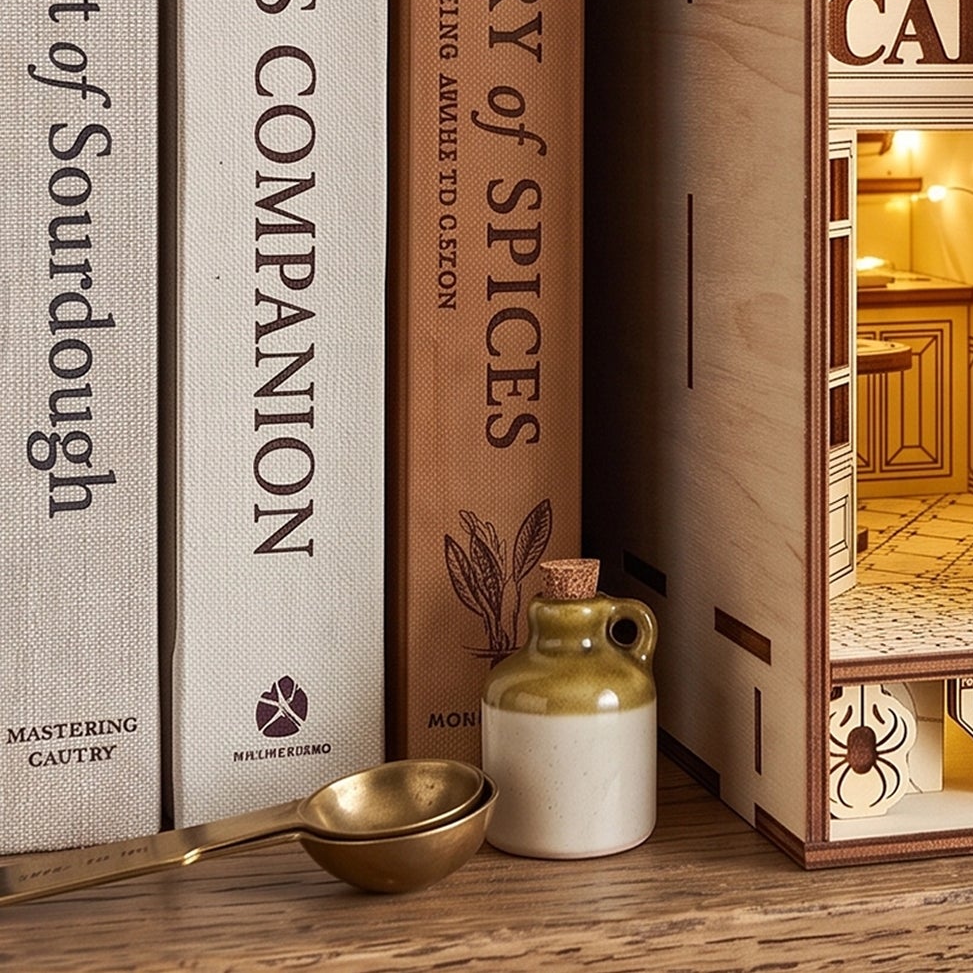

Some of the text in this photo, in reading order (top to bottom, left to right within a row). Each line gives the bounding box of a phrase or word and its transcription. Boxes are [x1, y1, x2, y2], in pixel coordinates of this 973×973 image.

[28, 41, 111, 109] of
[471, 84, 548, 157] of
[26, 123, 116, 519] Sourdough
[253, 45, 317, 557] COMPANION
[485, 178, 542, 449] SPICES
[7, 716, 138, 745] MASTERING
[28, 744, 118, 768] CAUTRY
